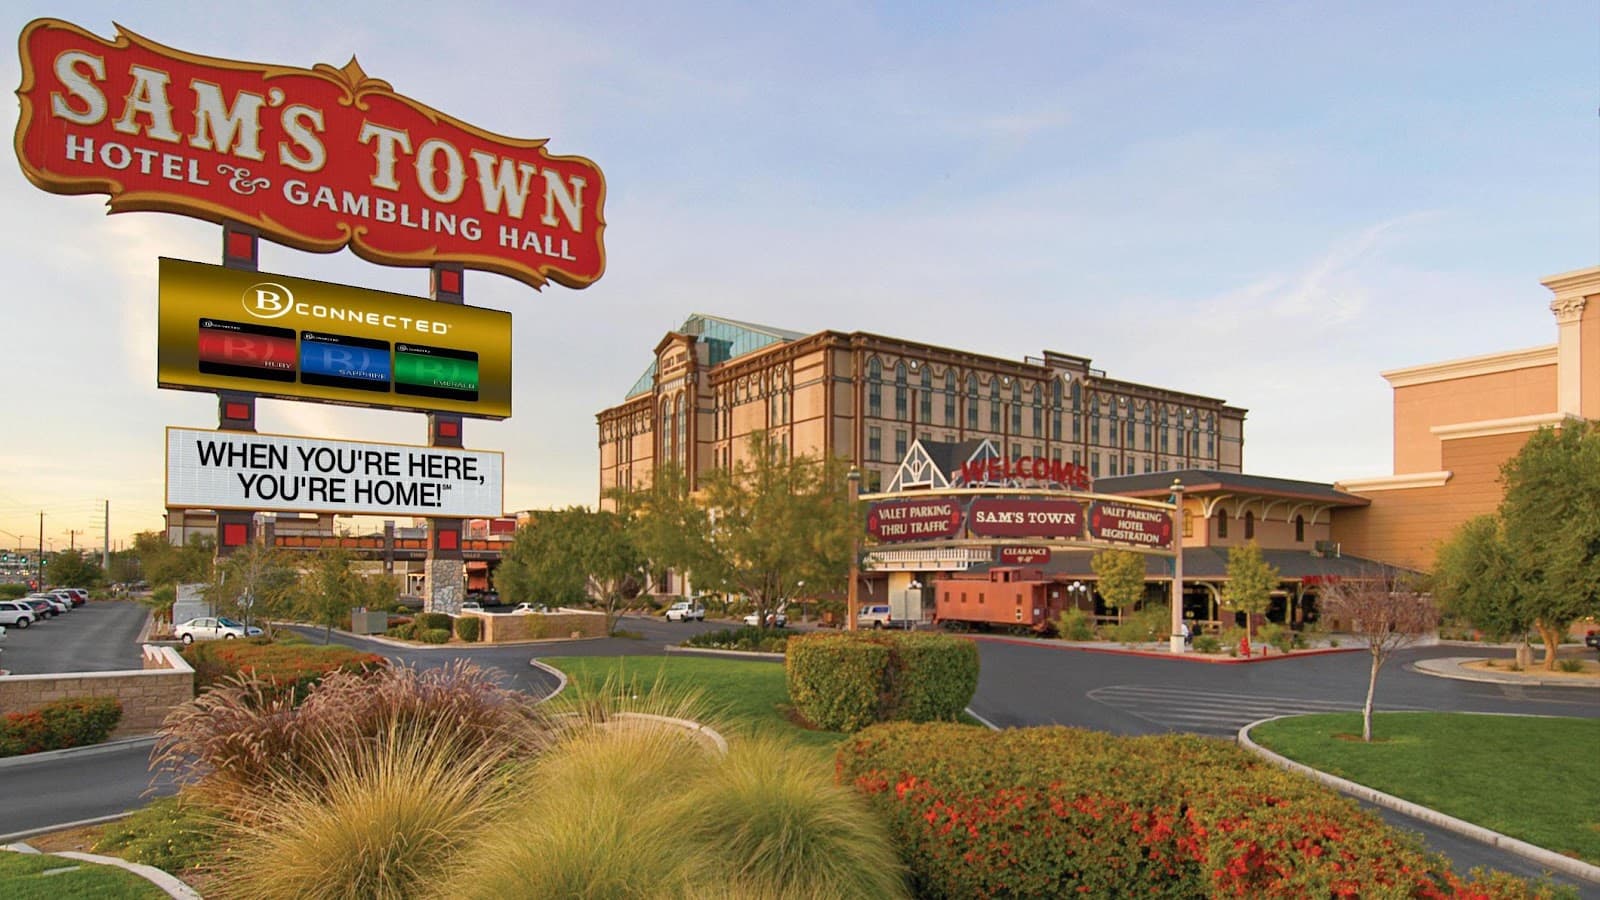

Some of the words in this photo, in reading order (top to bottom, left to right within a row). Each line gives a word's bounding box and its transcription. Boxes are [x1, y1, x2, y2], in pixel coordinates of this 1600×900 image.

[50, 49, 327, 172] SAM'S
[358, 121, 588, 233] TOWN
[65, 134, 209, 187] HOTEL
[216, 163, 270, 195] &
[282, 180, 482, 241] GAMBLING
[499, 225, 577, 261] HALL
[196, 440, 288, 470] WHEN
[297, 446, 400, 476] YOU'RE
[409, 453, 485, 485] HERE,
[960, 456, 1090, 489] WELCOME
[237, 473, 346, 503] YOU'RE
[354, 479, 442, 507] HOME!
[879, 508, 907, 519] VALET
[910, 505, 951, 518] PARKING
[976, 511, 1024, 523] SAM'S
[1028, 512, 1076, 525] TOWN
[1102, 505, 1125, 518] VALET
[1125, 509, 1162, 523] PARKING
[881, 523, 908, 536] THRU
[911, 520, 949, 533] TRAFFIC
[1118, 520, 1144, 531] HOTEL
[1101, 527, 1160, 543] REGISTRATION
